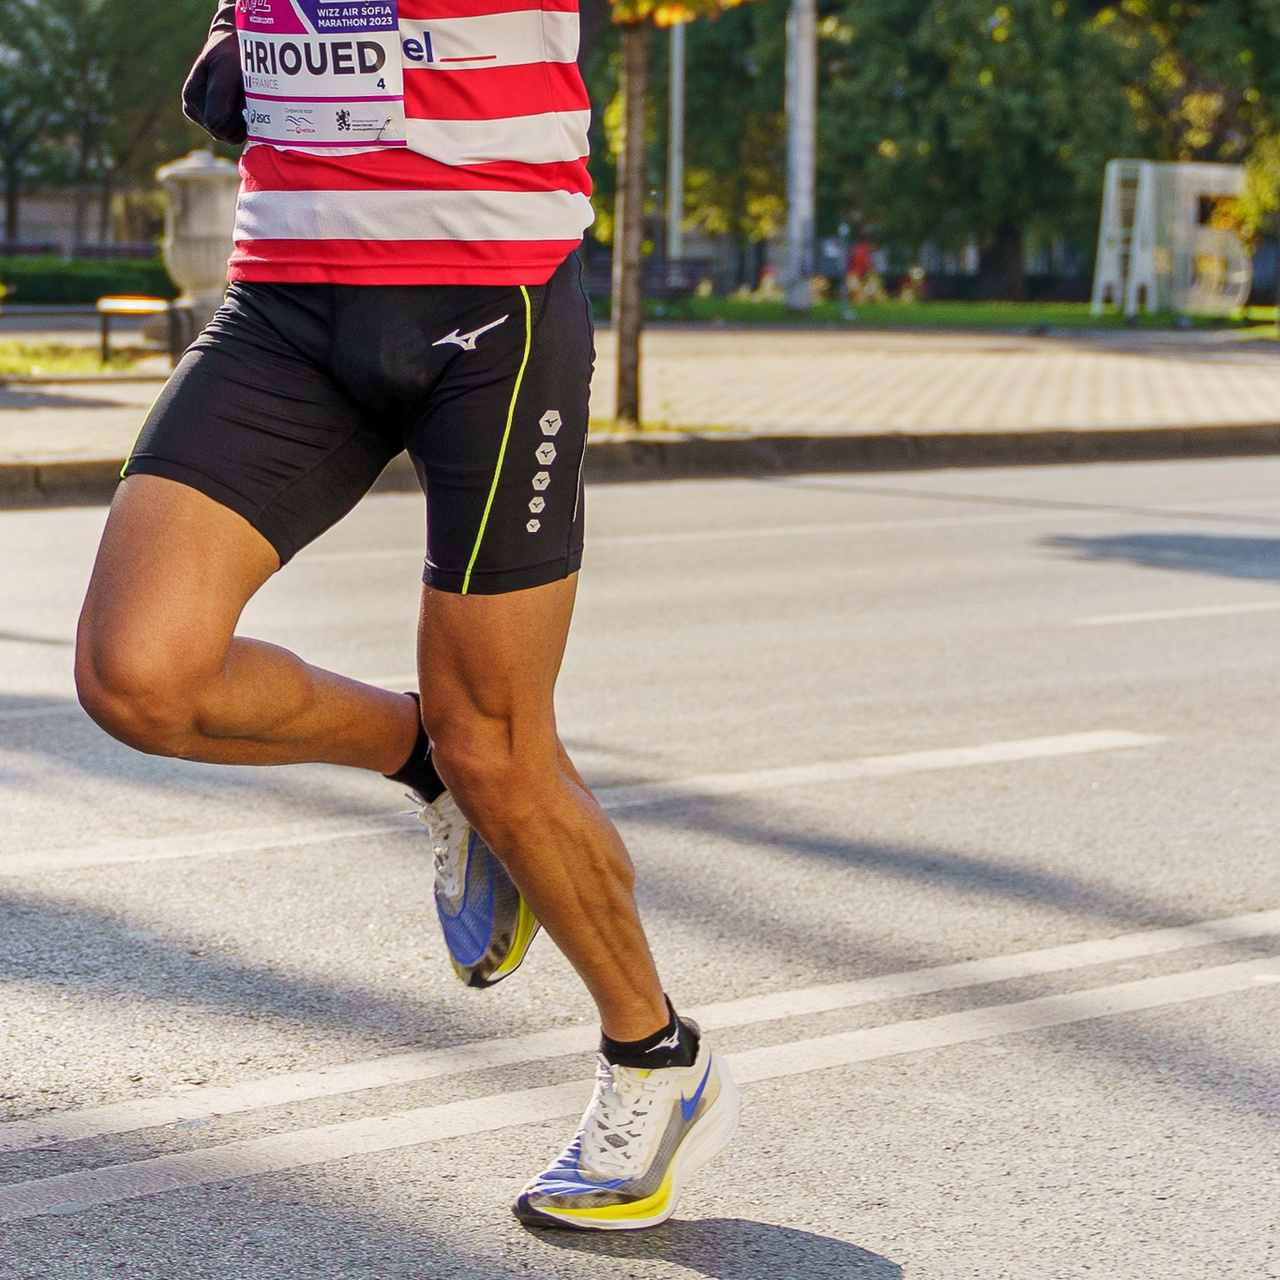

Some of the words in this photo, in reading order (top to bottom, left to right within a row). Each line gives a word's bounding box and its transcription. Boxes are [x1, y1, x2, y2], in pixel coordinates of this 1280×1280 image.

[317, 8, 340, 17] WIZZ
[342, 7, 359, 17] AIR
[361, 5, 392, 16] SOFIA
[318, 17, 367, 28] MARATHON
[369, 16, 393, 27] 2023
[243, 39, 387, 76] HRIOUED
[251, 77, 280, 90] FRANCE
[376, 77, 386, 90] 4
